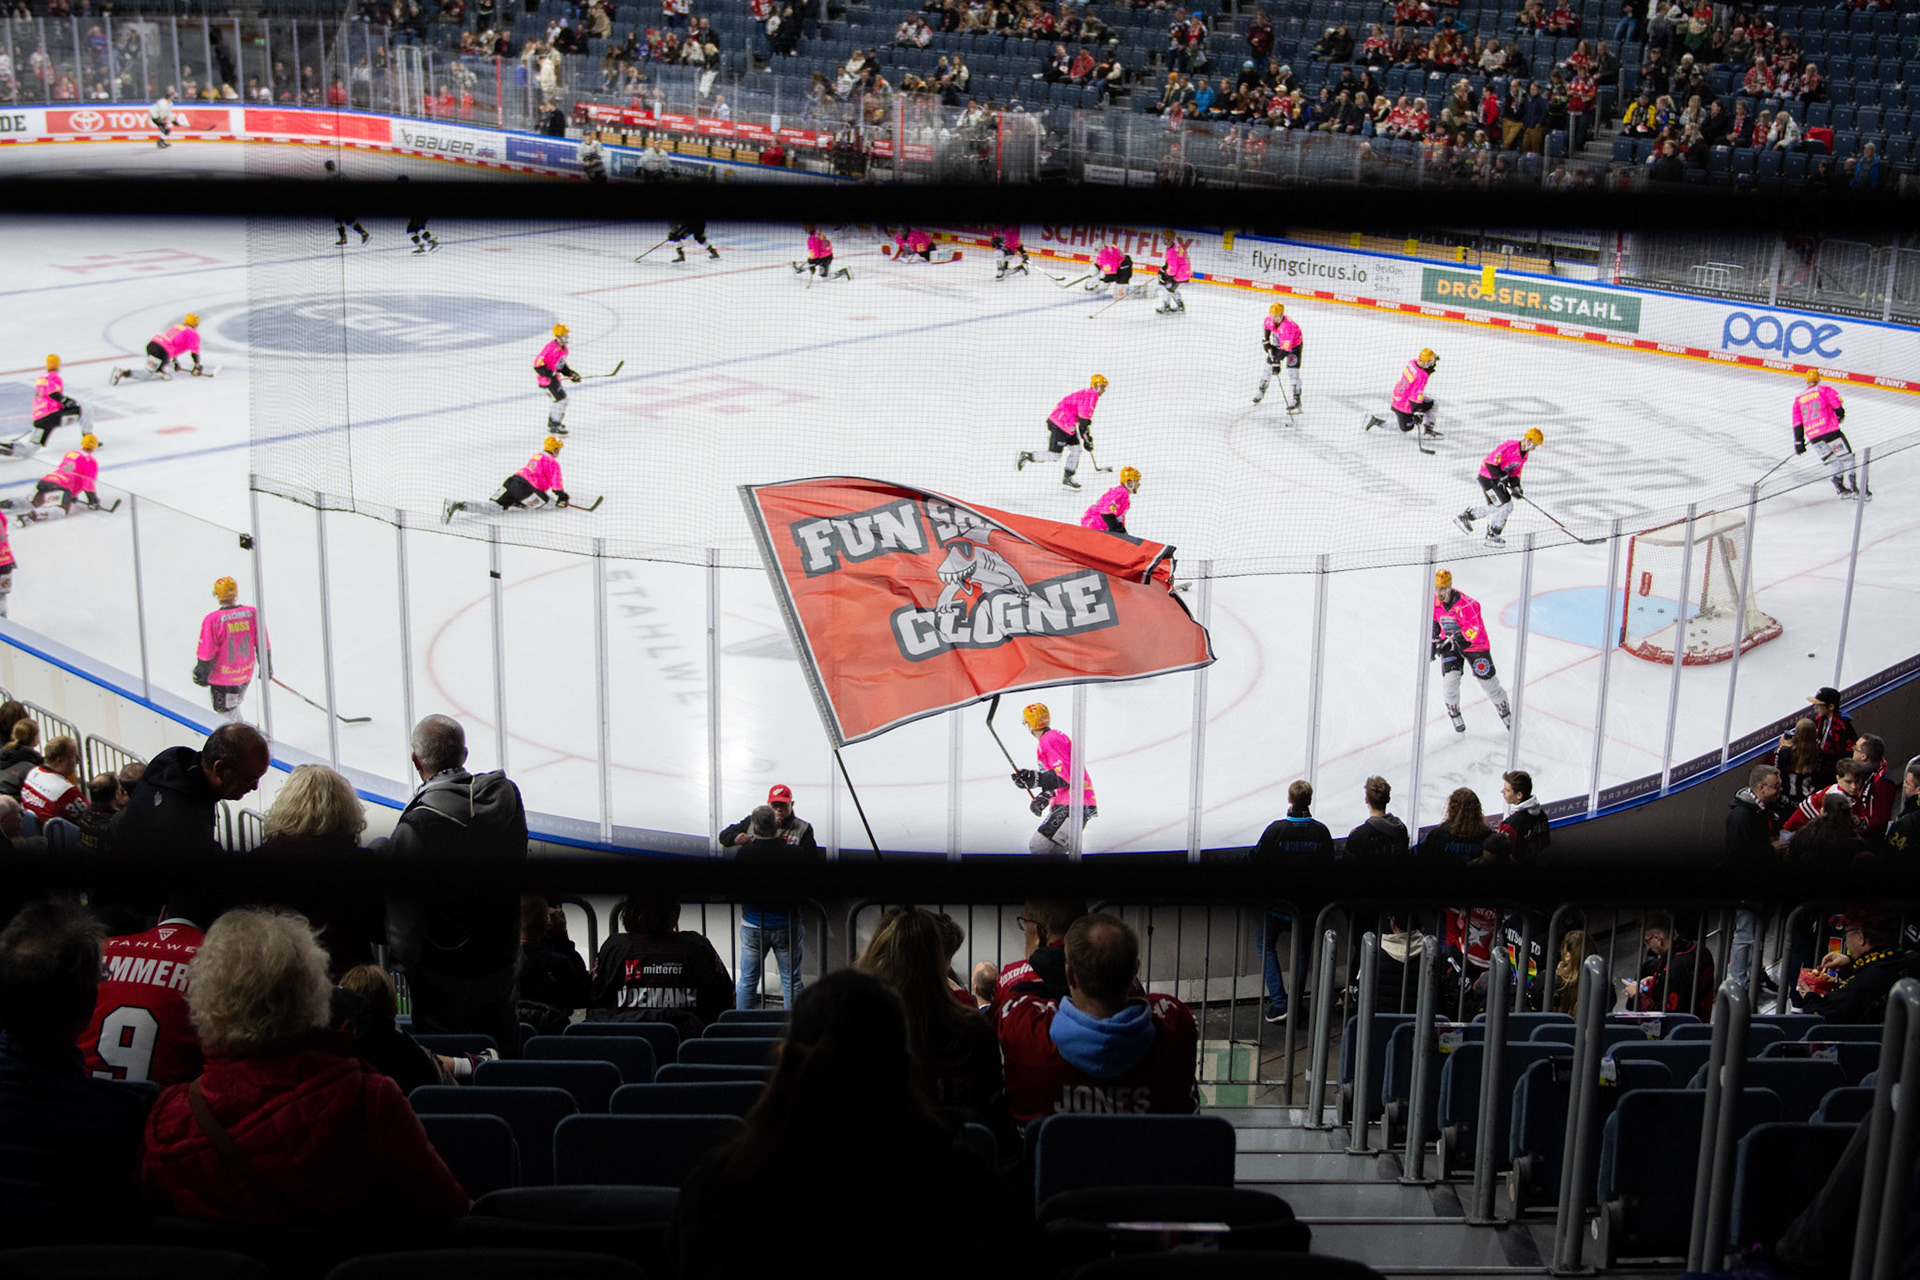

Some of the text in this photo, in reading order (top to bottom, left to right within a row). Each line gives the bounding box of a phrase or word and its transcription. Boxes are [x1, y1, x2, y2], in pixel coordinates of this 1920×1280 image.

[107, 112, 190, 128] TOYA
[1252, 249, 1367, 283] flyingcircus.io
[1722, 312, 1843, 358] pape
[798, 504, 922, 571] FUN
[228, 621, 250, 633] ROSS
[228, 633, 250, 663] 14
[643, 964, 683, 975] mitterer
[92, 1005, 159, 1080] 9
[1053, 1084, 1150, 1113] JONES
